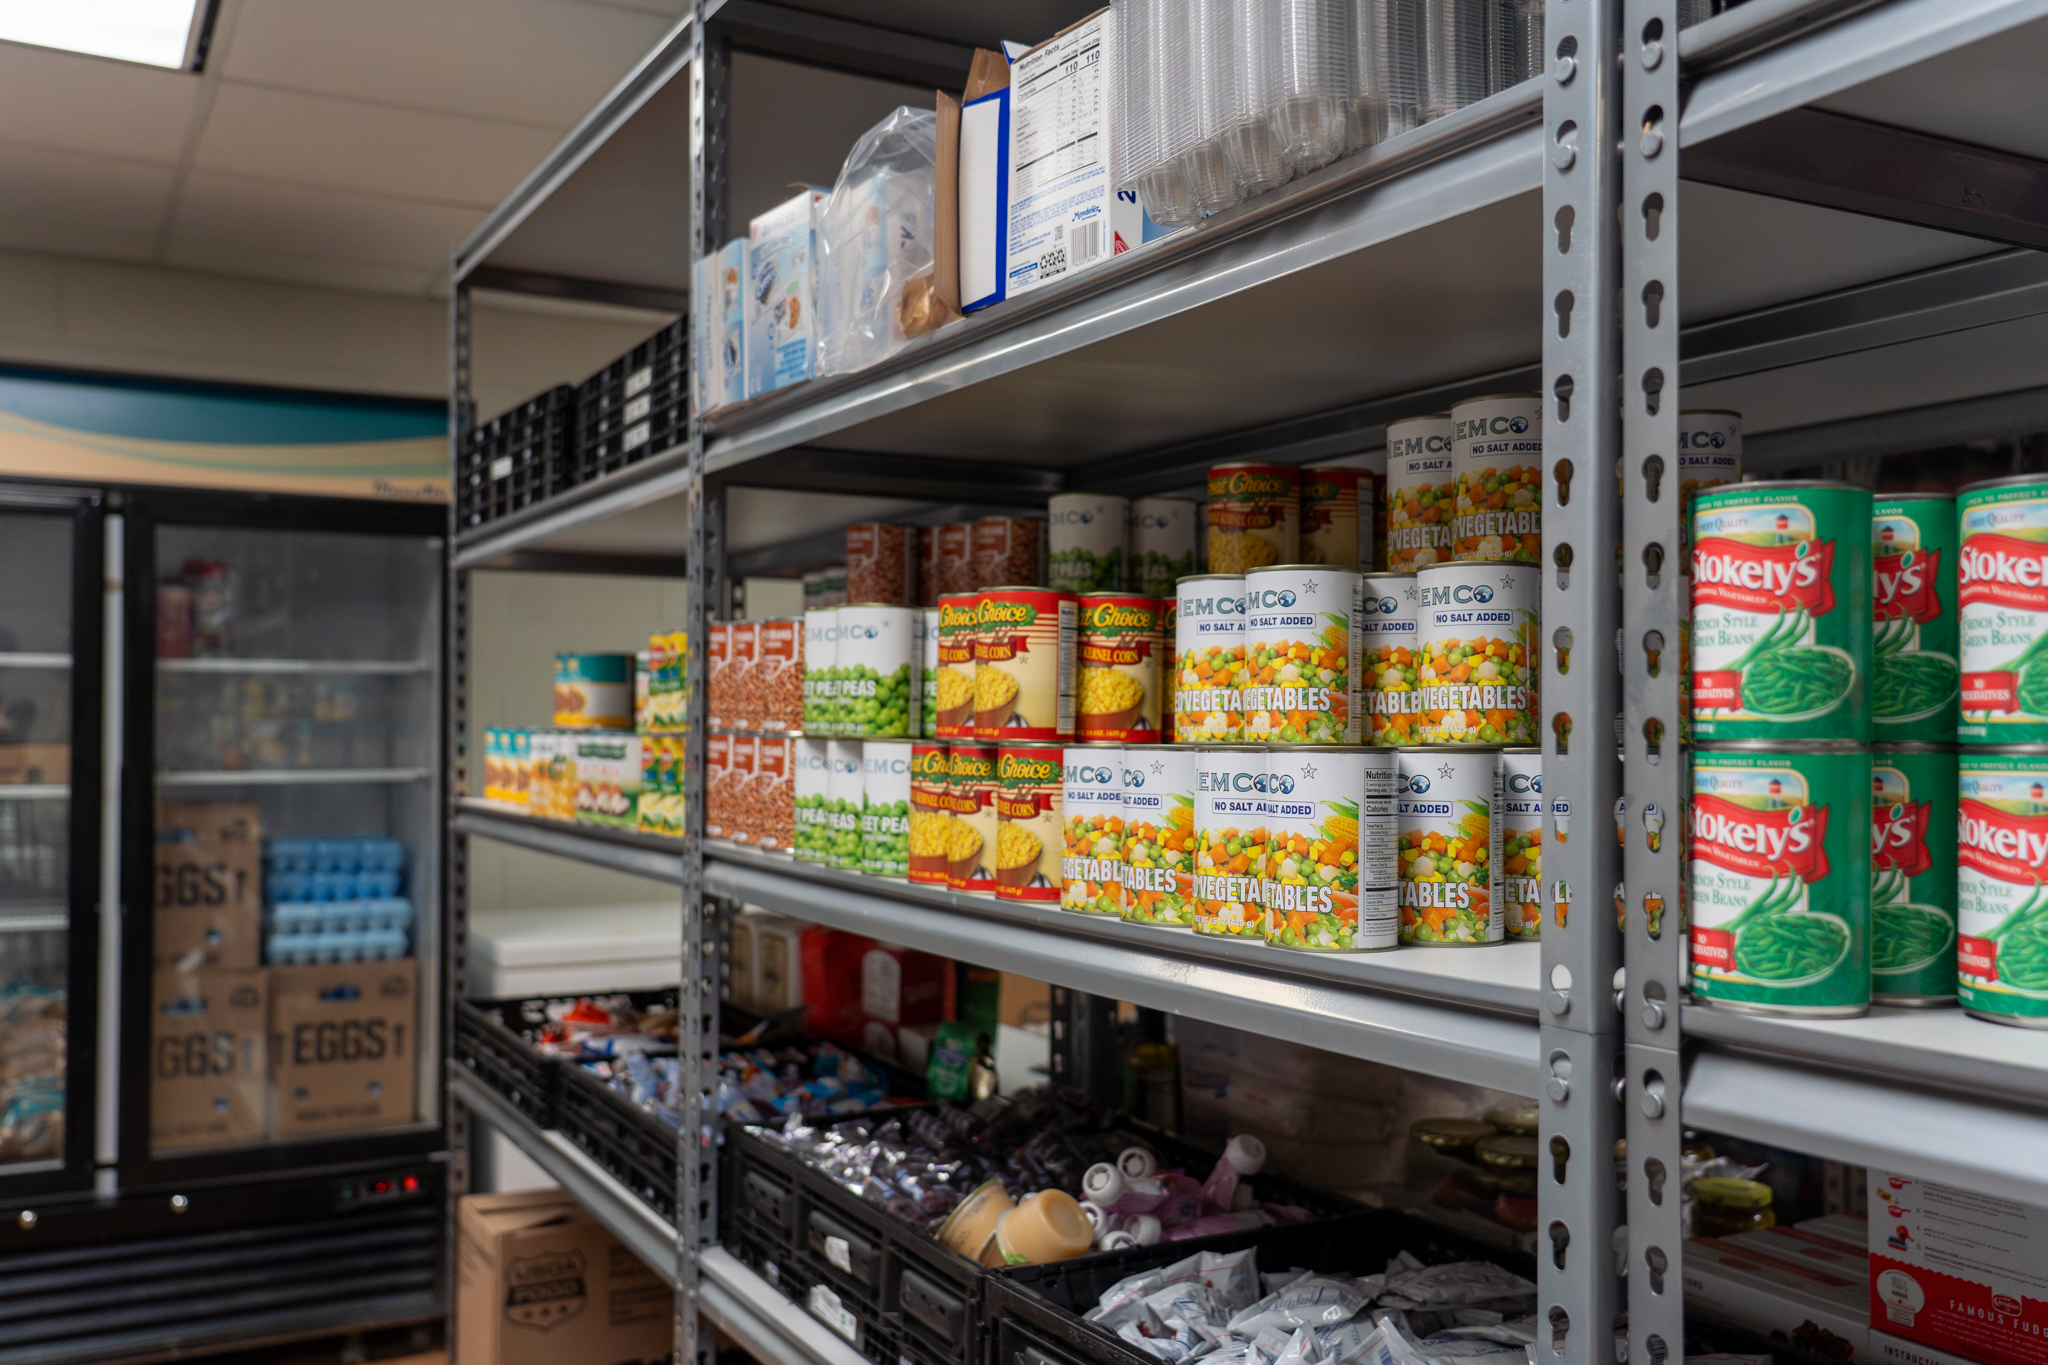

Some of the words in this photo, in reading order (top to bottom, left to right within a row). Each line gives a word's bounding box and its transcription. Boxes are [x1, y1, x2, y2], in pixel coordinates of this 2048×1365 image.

[1044, 44, 1060, 58] Facts
[1086, 50, 1100, 64] 110
[1065, 61, 1078, 74] 110
[1472, 445, 1484, 454] NO
[1487, 443, 1509, 453] SALT
[1513, 442, 1542, 451] ADDED
[1678, 431, 1725, 449] MCO
[1409, 462, 1420, 471] NO
[1423, 461, 1443, 470] SALT
[1678, 458, 1686, 466] O
[1688, 457, 1710, 466] SALT
[1712, 457, 1735, 466] ADDED
[1229, 471, 1283, 495] Choice
[1724, 496, 1761, 506] PROTECT
[1764, 495, 1798, 503] FLAVOR
[1459, 511, 1541, 538] VEGETABL
[1715, 518, 1748, 531] QUALITY
[1987, 512, 2025, 528] QUALITY
[1394, 526, 1452, 549] VEGETA
[1960, 546, 2048, 588] Stokel
[1246, 590, 1296, 610] MCO
[1418, 585, 1494, 608] EMCO
[1718, 587, 1767, 604] VEGETABLES
[1991, 585, 2045, 602] VEGETABLES
[979, 598, 1027, 624] Choice
[1093, 603, 1151, 627] Choice
[1178, 597, 1246, 617] EMCO
[940, 604, 976, 628] Choic
[1250, 618, 1258, 626] NO
[1259, 617, 1277, 626] SALT
[1280, 616, 1313, 626] ADDED
[1436, 614, 1448, 623] NO
[1450, 613, 1474, 622] SALT
[1476, 612, 1510, 622] ADDED
[1722, 612, 1758, 629] STYLE
[1996, 611, 2036, 628] STYLE
[840, 625, 878, 639] MCO
[1199, 623, 1211, 632] NO
[1213, 623, 1235, 632] SALT
[1362, 623, 1379, 632] ALT
[1381, 622, 1414, 631] ADDED
[1718, 630, 1754, 646] BEANS
[1991, 629, 2032, 646] BEANS
[949, 648, 970, 661] CORN
[989, 645, 1011, 658] CORN
[1083, 646, 1111, 662] KERNEL
[1113, 649, 1138, 663] CORN
[843, 680, 877, 696] PEAS
[1701, 678, 1712, 688] NO
[1185, 688, 1245, 712] VEGETA
[1246, 686, 1331, 711] EGETABLES
[1362, 690, 1418, 714] ETABLE
[1423, 685, 1527, 711] VEGETABLES
[1212, 725, 1229, 734] (425
[1229, 726, 1237, 734] g)
[1450, 725, 1467, 735] (425
[1468, 725, 1477, 735] g)
[865, 758, 911, 774] EMC
[950, 752, 992, 776] Choice
[1001, 753, 1051, 779] Choice
[1757, 759, 1791, 767] FLAVOR
[2017, 762, 2048, 770] FLAVO
[1063, 766, 1112, 784] MCO
[1196, 768, 1266, 793] EMCO
[1366, 771, 1393, 779] Nutrition
[1709, 776, 1742, 790] QUALITY
[1068, 791, 1075, 799] NO
[1077, 792, 1094, 800] SALT
[1097, 792, 1121, 801] ADDE
[1133, 797, 1159, 806] ADDED
[957, 798, 977, 812] CORN
[1012, 802, 1035, 816] CORN
[1215, 802, 1226, 811] NO
[1229, 802, 1253, 811] SALT
[1268, 804, 1278, 814] SALT
[1281, 805, 1311, 815] ADDED
[1366, 805, 1388, 813] Calories
[1412, 804, 1449, 814] ADDED
[1506, 803, 1530, 812] SALT
[802, 807, 826, 824] PEA
[882, 816, 910, 833] PEA
[1958, 808, 2048, 869] tokely
[1712, 845, 1760, 868] VEGETABLES
[1062, 856, 1121, 882] EGETABL
[155, 864, 226, 907] GGS
[1121, 865, 1177, 893] ETABLES
[1717, 872, 1751, 890] STYLE
[1199, 875, 1265, 903] VEGETA
[1399, 881, 1470, 909] TABLES
[1979, 879, 2013, 898] STYLE
[1266, 882, 1333, 913] ETABLES
[1712, 889, 1748, 907] BEANS
[1975, 896, 2008, 914] BEANS
[1218, 918, 1227, 926] OZ
[1228, 918, 1245, 928] (425
[1246, 920, 1255, 928] g)
[1526, 920, 1534, 929] g)
[293, 1018, 386, 1065] EGGS
[157, 1032, 234, 1078] GGS
[1950, 1300, 2004, 1325] FAMOUS
[2013, 1318, 2048, 1338] FUDG
